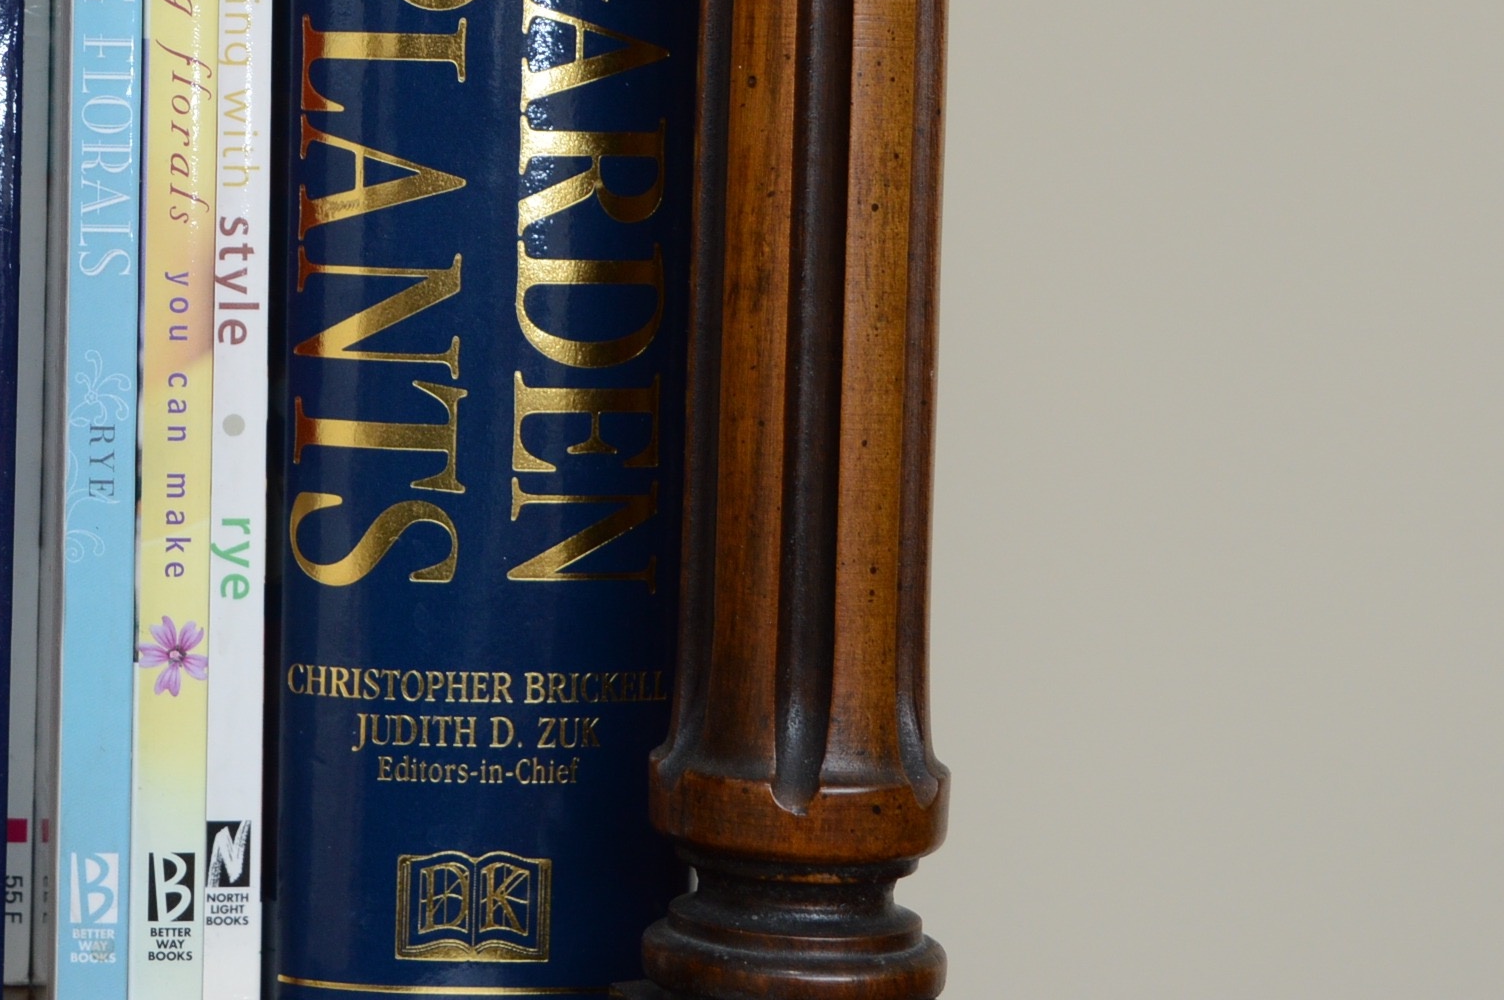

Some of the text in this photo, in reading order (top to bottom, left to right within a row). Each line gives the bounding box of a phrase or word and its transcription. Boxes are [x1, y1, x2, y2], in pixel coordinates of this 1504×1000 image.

[156, 38, 214, 225] florals
[221, 89, 260, 190] with
[78, 34, 137, 280] FLORALS
[214, 215, 261, 346] style
[164, 271, 189, 342] you
[166, 371, 188, 443] can
[88, 422, 116, 499] RYE
[164, 471, 192, 578] make
[210, 516, 251, 601] rye
[287, 663, 668, 705] CHRISTOPHER BRICKELL
[351, 712, 602, 752] JUDITH D. ZUK
[376, 755, 581, 785] Editors-in-Chief
[4, 875, 23, 904] 55
[206, 892, 250, 903] NORTH
[210, 903, 246, 914] LIGHT
[419, 862, 530, 936] DK
[72, 928, 116, 940] BETTER
[149, 927, 192, 938] BETTER
[205, 915, 250, 926] BOOKS
[70, 952, 117, 963] BOOKS
[78, 940, 109, 951] WAY
[148, 951, 194, 962] BOOKS
[155, 939, 186, 950] WAY
